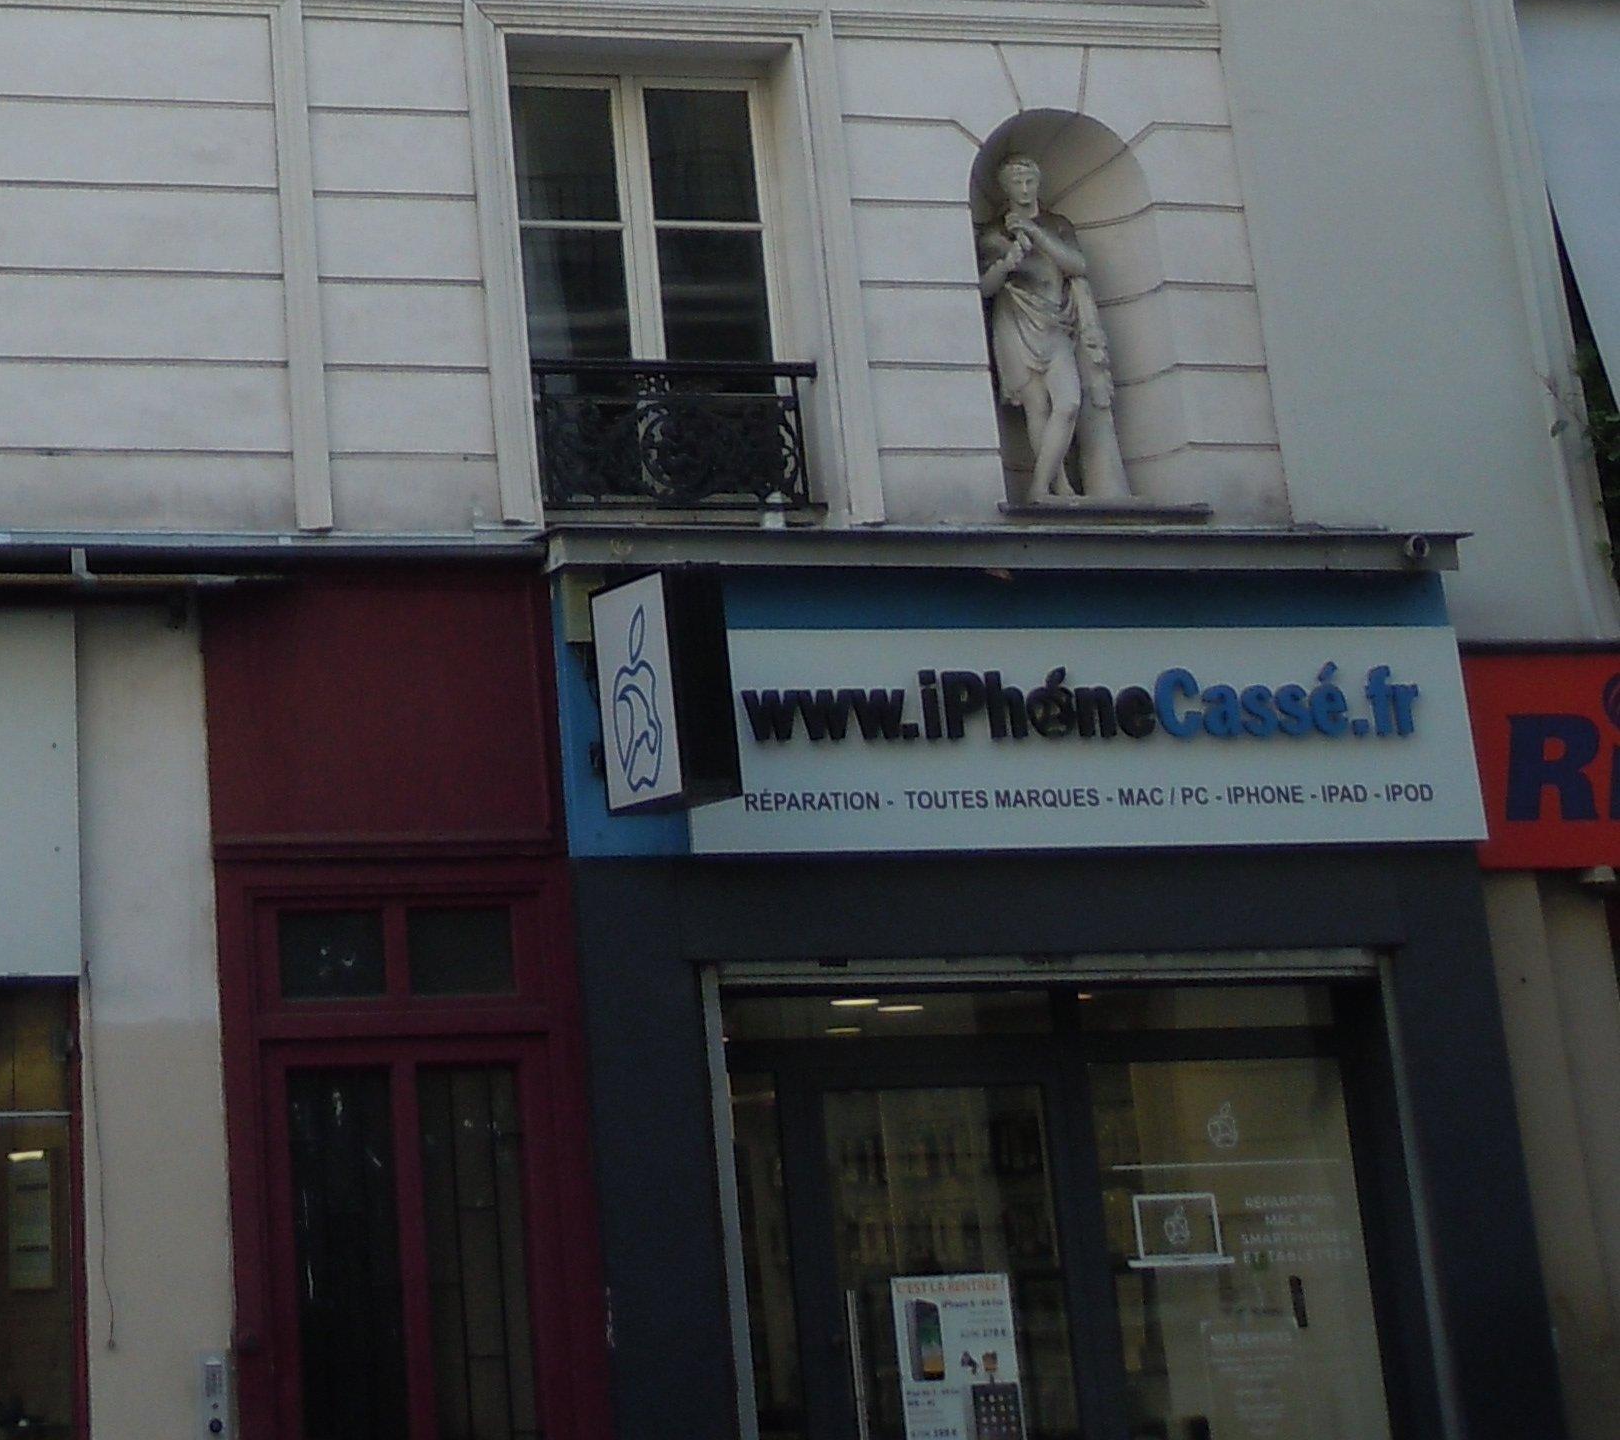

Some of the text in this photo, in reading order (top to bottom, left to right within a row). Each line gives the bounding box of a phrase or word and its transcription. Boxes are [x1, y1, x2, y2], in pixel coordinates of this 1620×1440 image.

[744, 788, 881, 812] RÉPARATION
[903, 789, 990, 810] TOUTES
[994, 787, 1101, 809] MARQUES
[1117, 786, 1165, 807] MAC
[1181, 785, 1210, 806] PC
[1226, 784, 1305, 805] IPHONE
[1321, 783, 1368, 804] IPAD
[1385, 783, 1434, 803] IPOD
